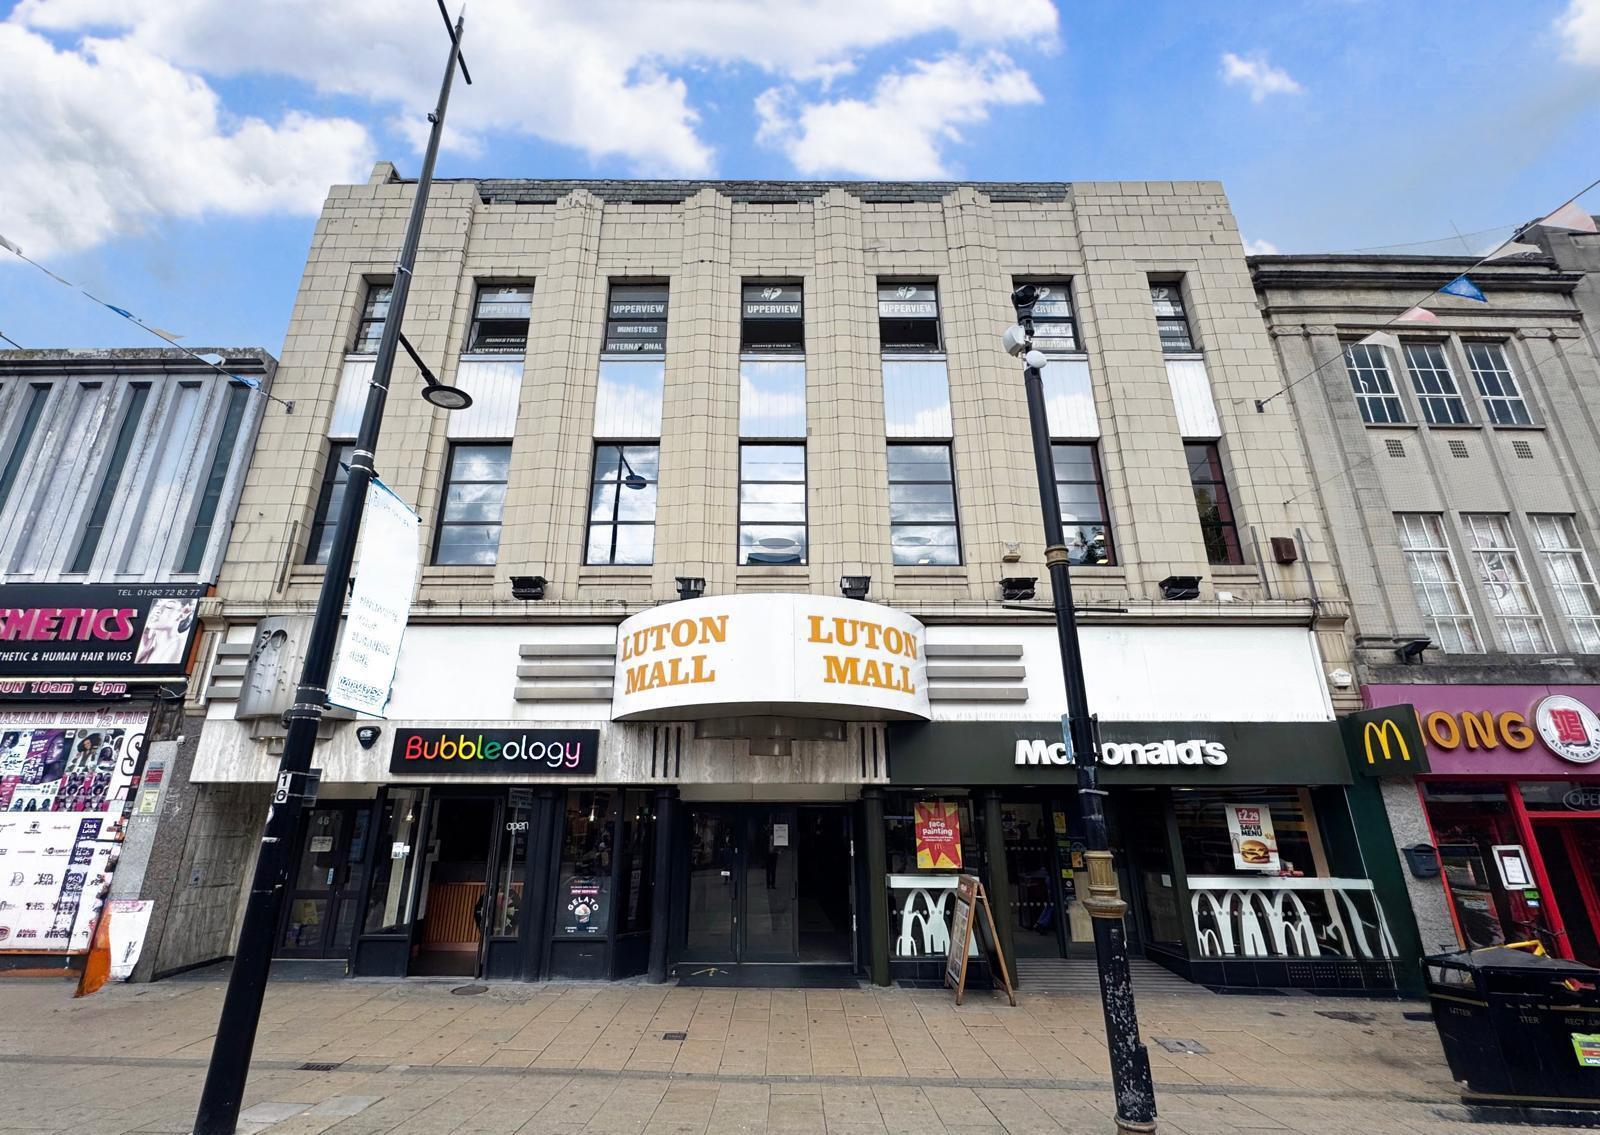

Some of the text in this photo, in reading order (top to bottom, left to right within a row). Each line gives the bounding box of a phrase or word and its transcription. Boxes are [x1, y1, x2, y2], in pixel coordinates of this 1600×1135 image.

[613, 304, 665, 314] UPPERVIEW
[747, 304, 799, 314] UPPERVIEW
[882, 303, 932, 313] UPPERVIEW
[616, 326, 658, 334] MINISTRIES
[137, 589, 163, 597] 01582
[164, 589, 175, 597] 72
[177, 589, 188, 597] 82
[190, 589, 200, 597] 77
[621, 615, 729, 662] LUTON
[808, 615, 917, 661] LUTON
[31, 652, 38, 661] &
[41, 652, 77, 661] HUMAN
[80, 652, 104, 661] HAIR
[107, 652, 132, 662] WIGS
[624, 654, 715, 695] MALL
[823, 655, 915, 694] MALL
[31, 681, 74, 694] 10am
[92, 682, 127, 696] 5pm
[60, 711, 95, 725] HAIR
[404, 734, 581, 768] Bubbleology
[1014, 739, 1228, 766] Mconald's
[1569, 792, 1600, 806] OPE
[506, 821, 529, 835] open
[922, 828, 953, 836] Painting
[1241, 829, 1263, 837] MENU
[567, 896, 599, 911] GELATO
